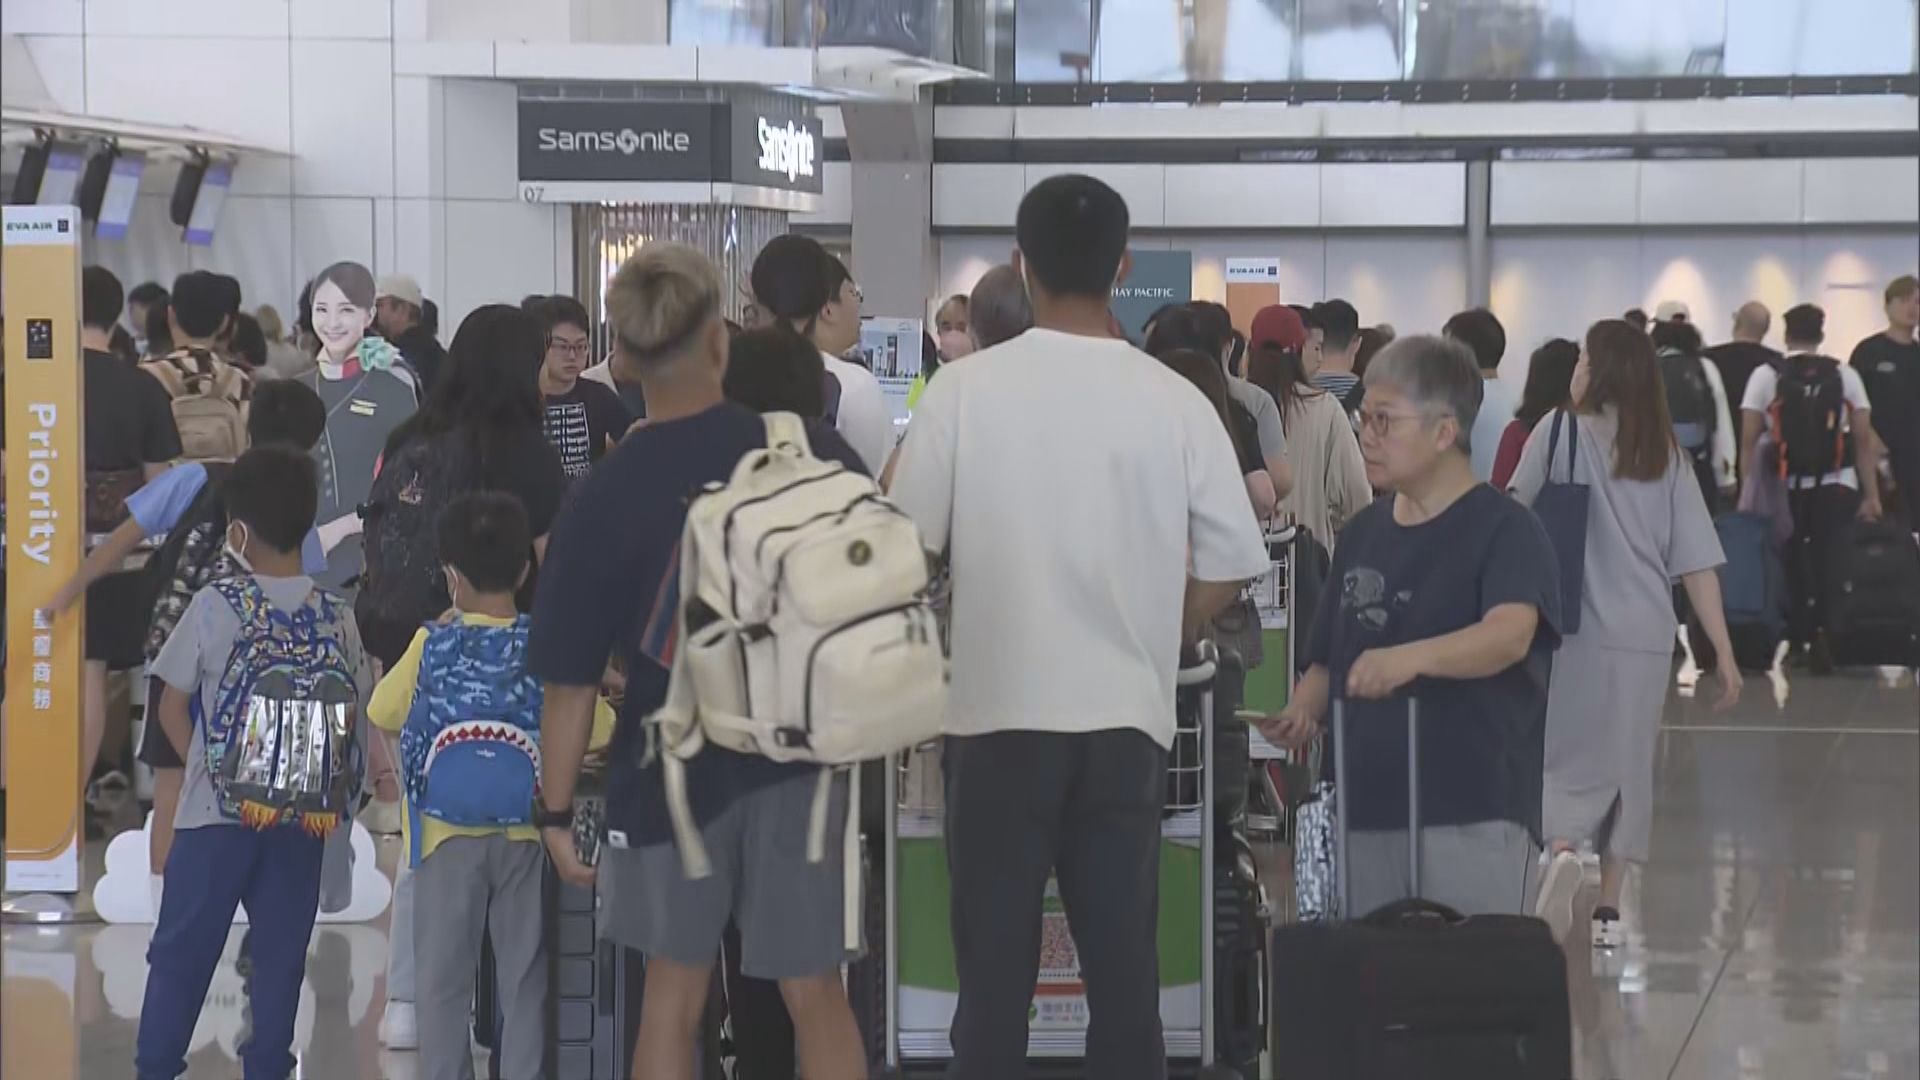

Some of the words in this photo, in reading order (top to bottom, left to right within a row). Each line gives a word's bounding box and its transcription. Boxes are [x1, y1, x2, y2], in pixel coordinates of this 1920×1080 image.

[538, 127, 690, 154] Samsonite
[757, 116, 815, 182] Samsonite
[524, 186, 545, 205] 07
[6, 222, 30, 232] EVA
[32, 222, 53, 231] AIR
[1134, 287, 1175, 298] PACIFIC
[22, 402, 58, 566] Priority
